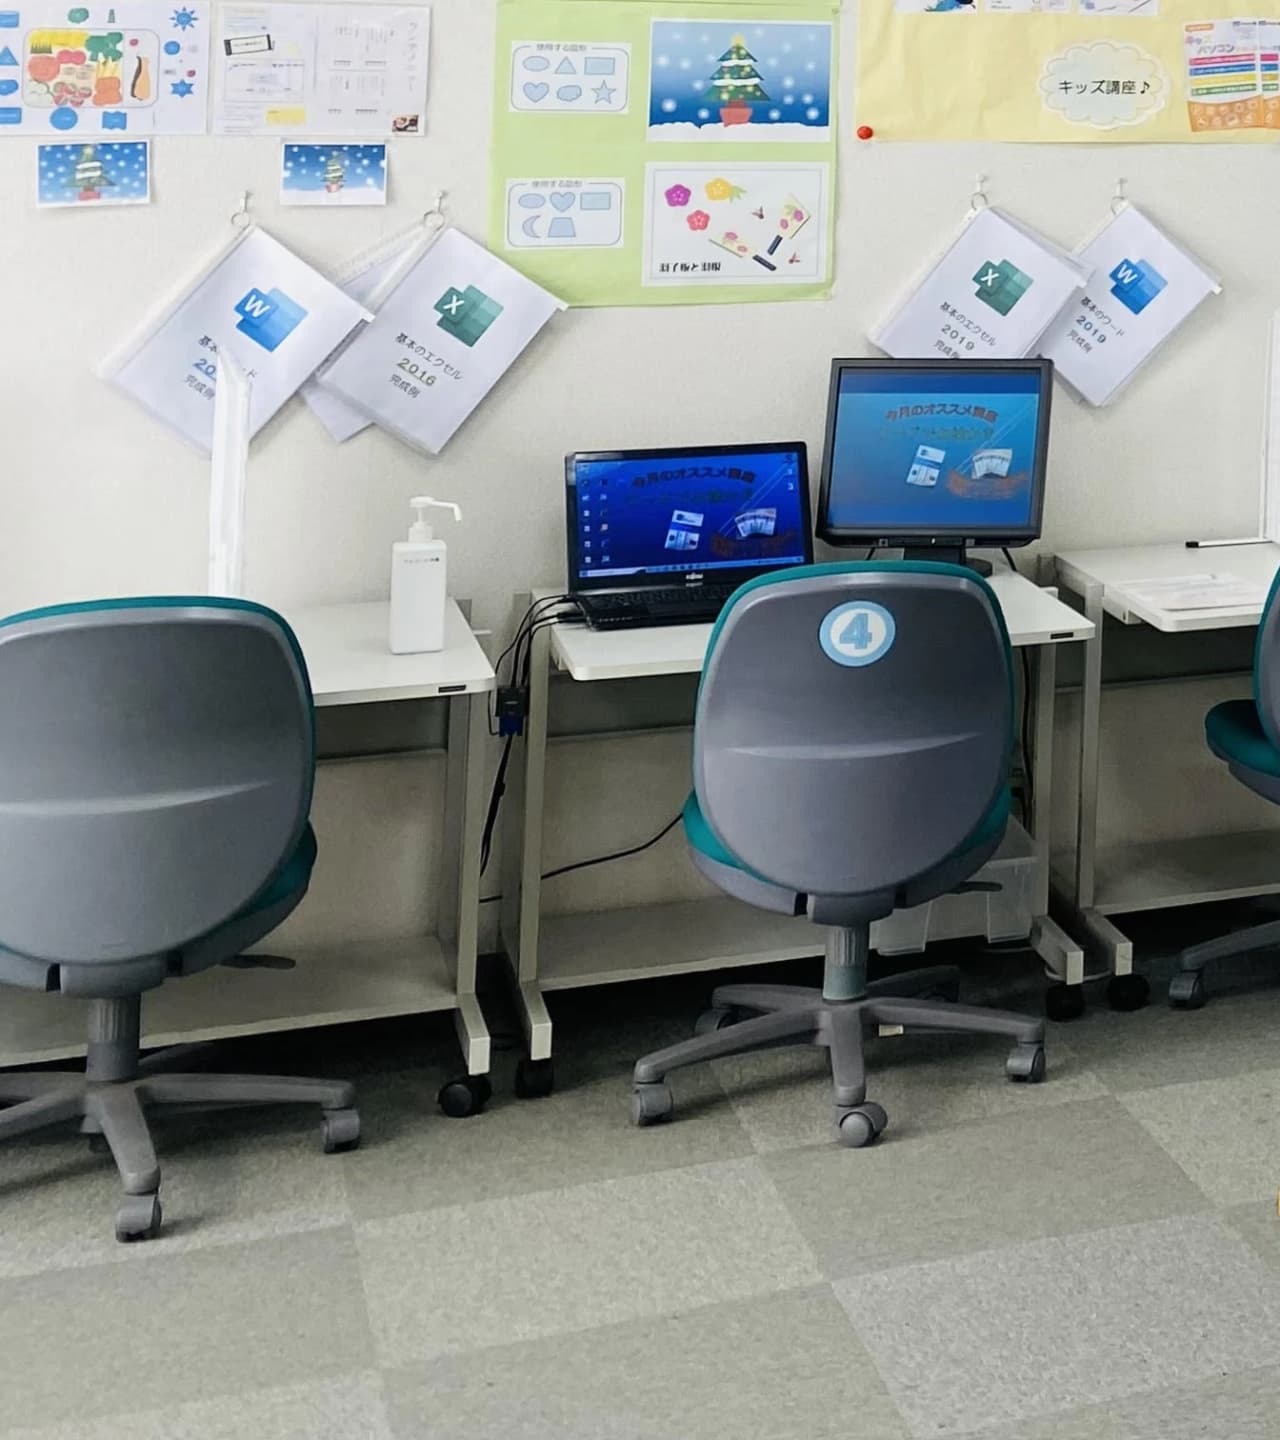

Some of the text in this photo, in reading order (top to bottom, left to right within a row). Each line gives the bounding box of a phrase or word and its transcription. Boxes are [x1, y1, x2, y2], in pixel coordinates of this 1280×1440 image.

[981, 268, 999, 287] X
[1117, 264, 1137, 284] W
[245, 294, 270, 317] W
[444, 295, 464, 315] X
[1080, 296, 1126, 338] 基本のワード
[939, 301, 997, 347] 基本のエクセル
[940, 323, 975, 352] 2019
[1076, 316, 1106, 344] 2019
[395, 331, 462, 380] 基本のエクセル
[397, 358, 437, 387] 2016
[840, 613, 873, 651] 4
